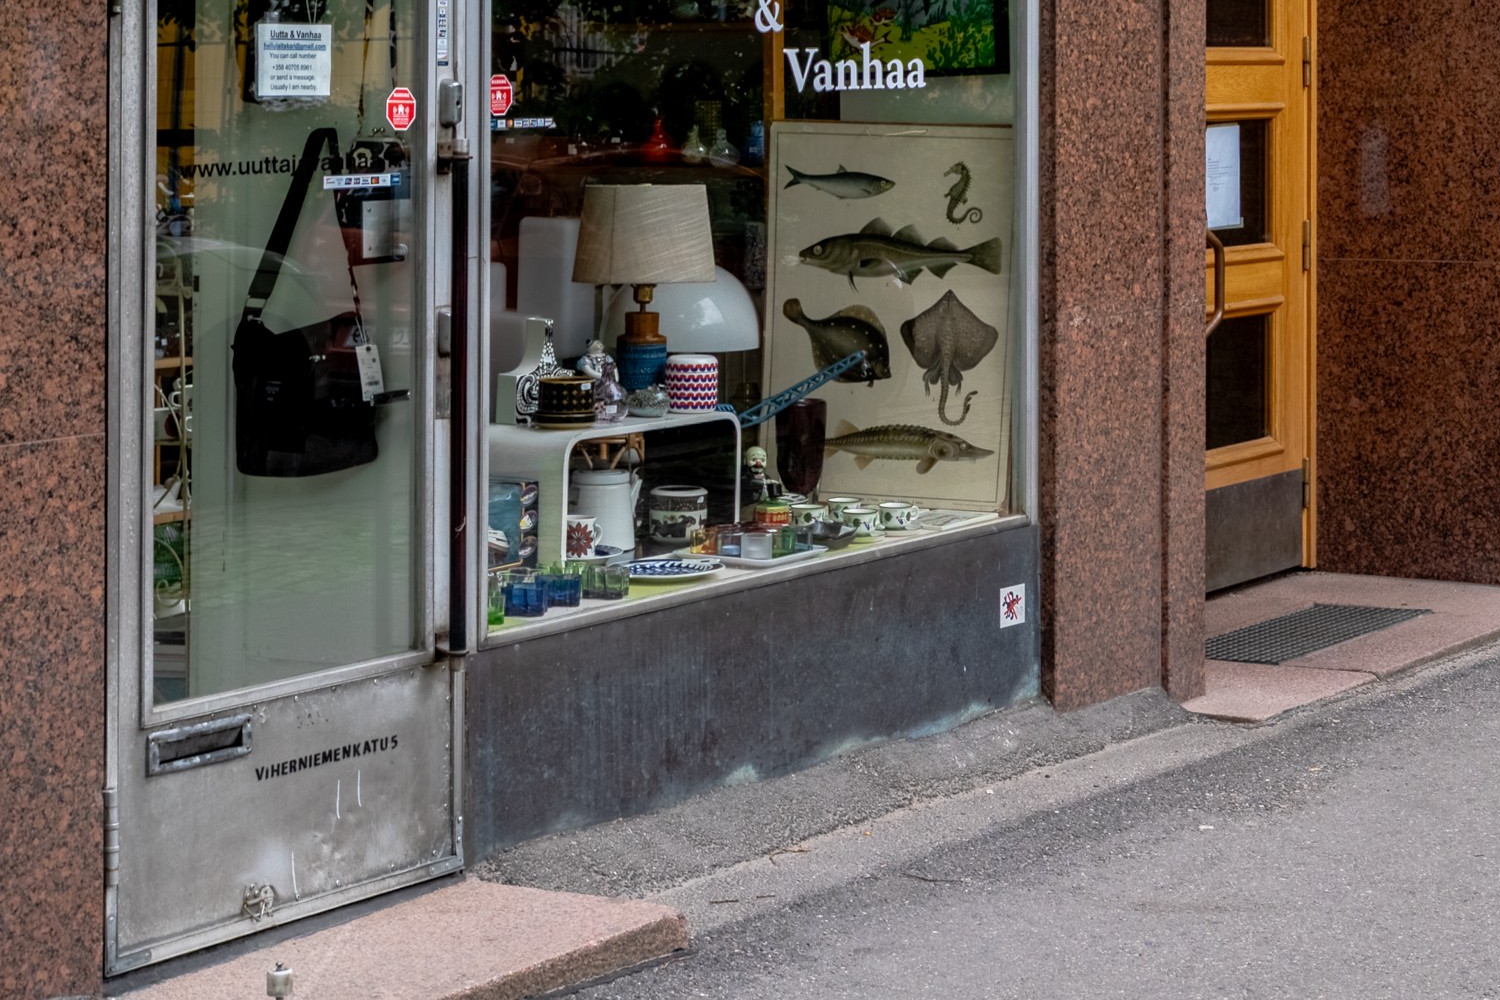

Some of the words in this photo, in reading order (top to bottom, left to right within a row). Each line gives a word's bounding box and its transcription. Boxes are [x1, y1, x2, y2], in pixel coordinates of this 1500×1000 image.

[270, 30, 288, 39] Uutta
[290, 30, 295, 38] &
[296, 30, 322, 39] Vanhaa
[783, 41, 926, 93] Vanhaa
